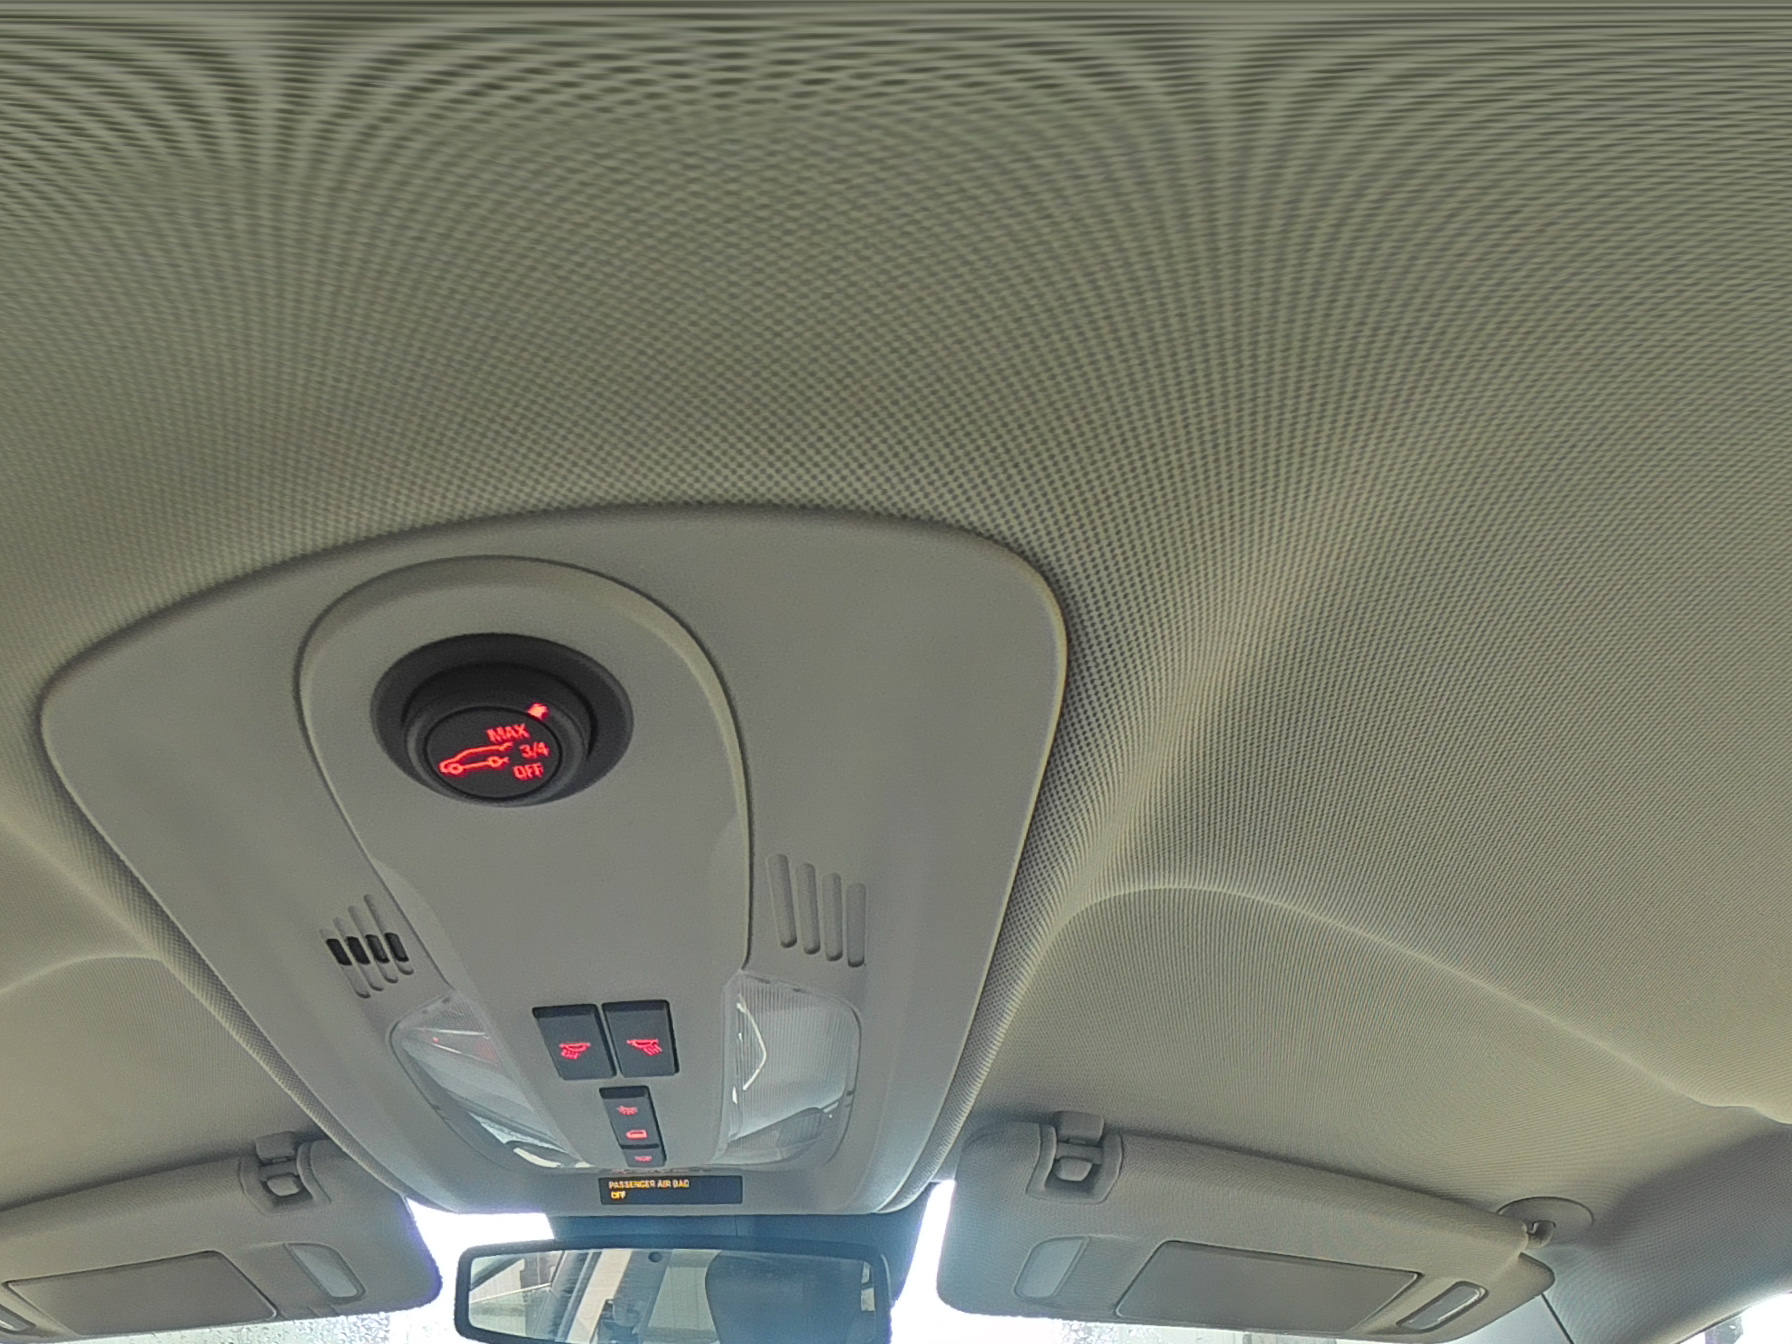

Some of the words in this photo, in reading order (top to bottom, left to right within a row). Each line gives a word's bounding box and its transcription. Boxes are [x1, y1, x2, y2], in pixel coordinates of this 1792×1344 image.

[487, 723, 530, 743] MAX
[519, 741, 550, 759] 3/4
[513, 762, 544, 779] OFF
[608, 1180, 656, 1190] PASSENGER
[657, 1180, 671, 1189] AIR
